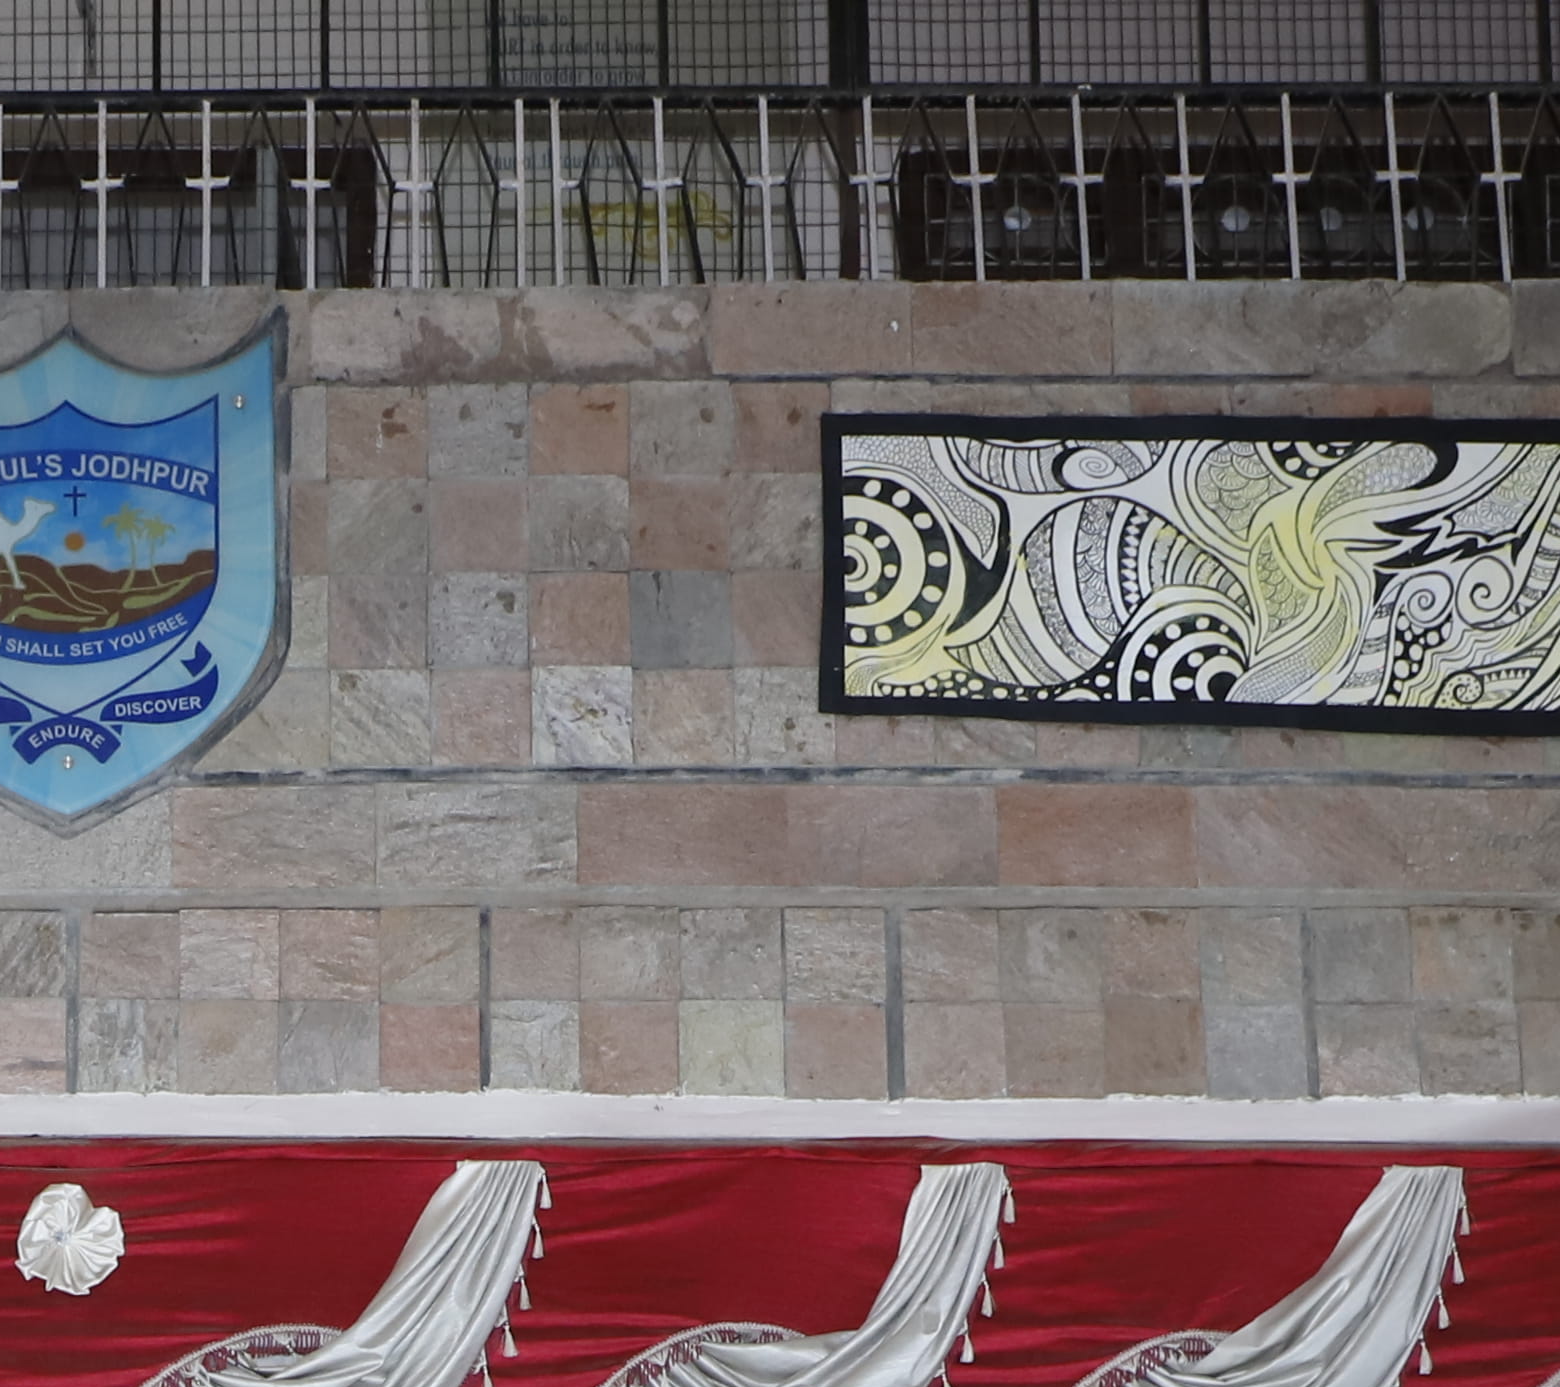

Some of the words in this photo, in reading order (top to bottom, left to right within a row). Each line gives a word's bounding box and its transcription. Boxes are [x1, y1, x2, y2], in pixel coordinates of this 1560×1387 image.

[71, 454, 210, 498] JODHPUR
[5, 636, 65, 658] SHALL
[69, 637, 106, 658] SET
[108, 625, 149, 652] YOU
[148, 612, 188, 643] FREE
[113, 695, 203, 718] DISCOVER
[27, 724, 106, 751] ENDURE
